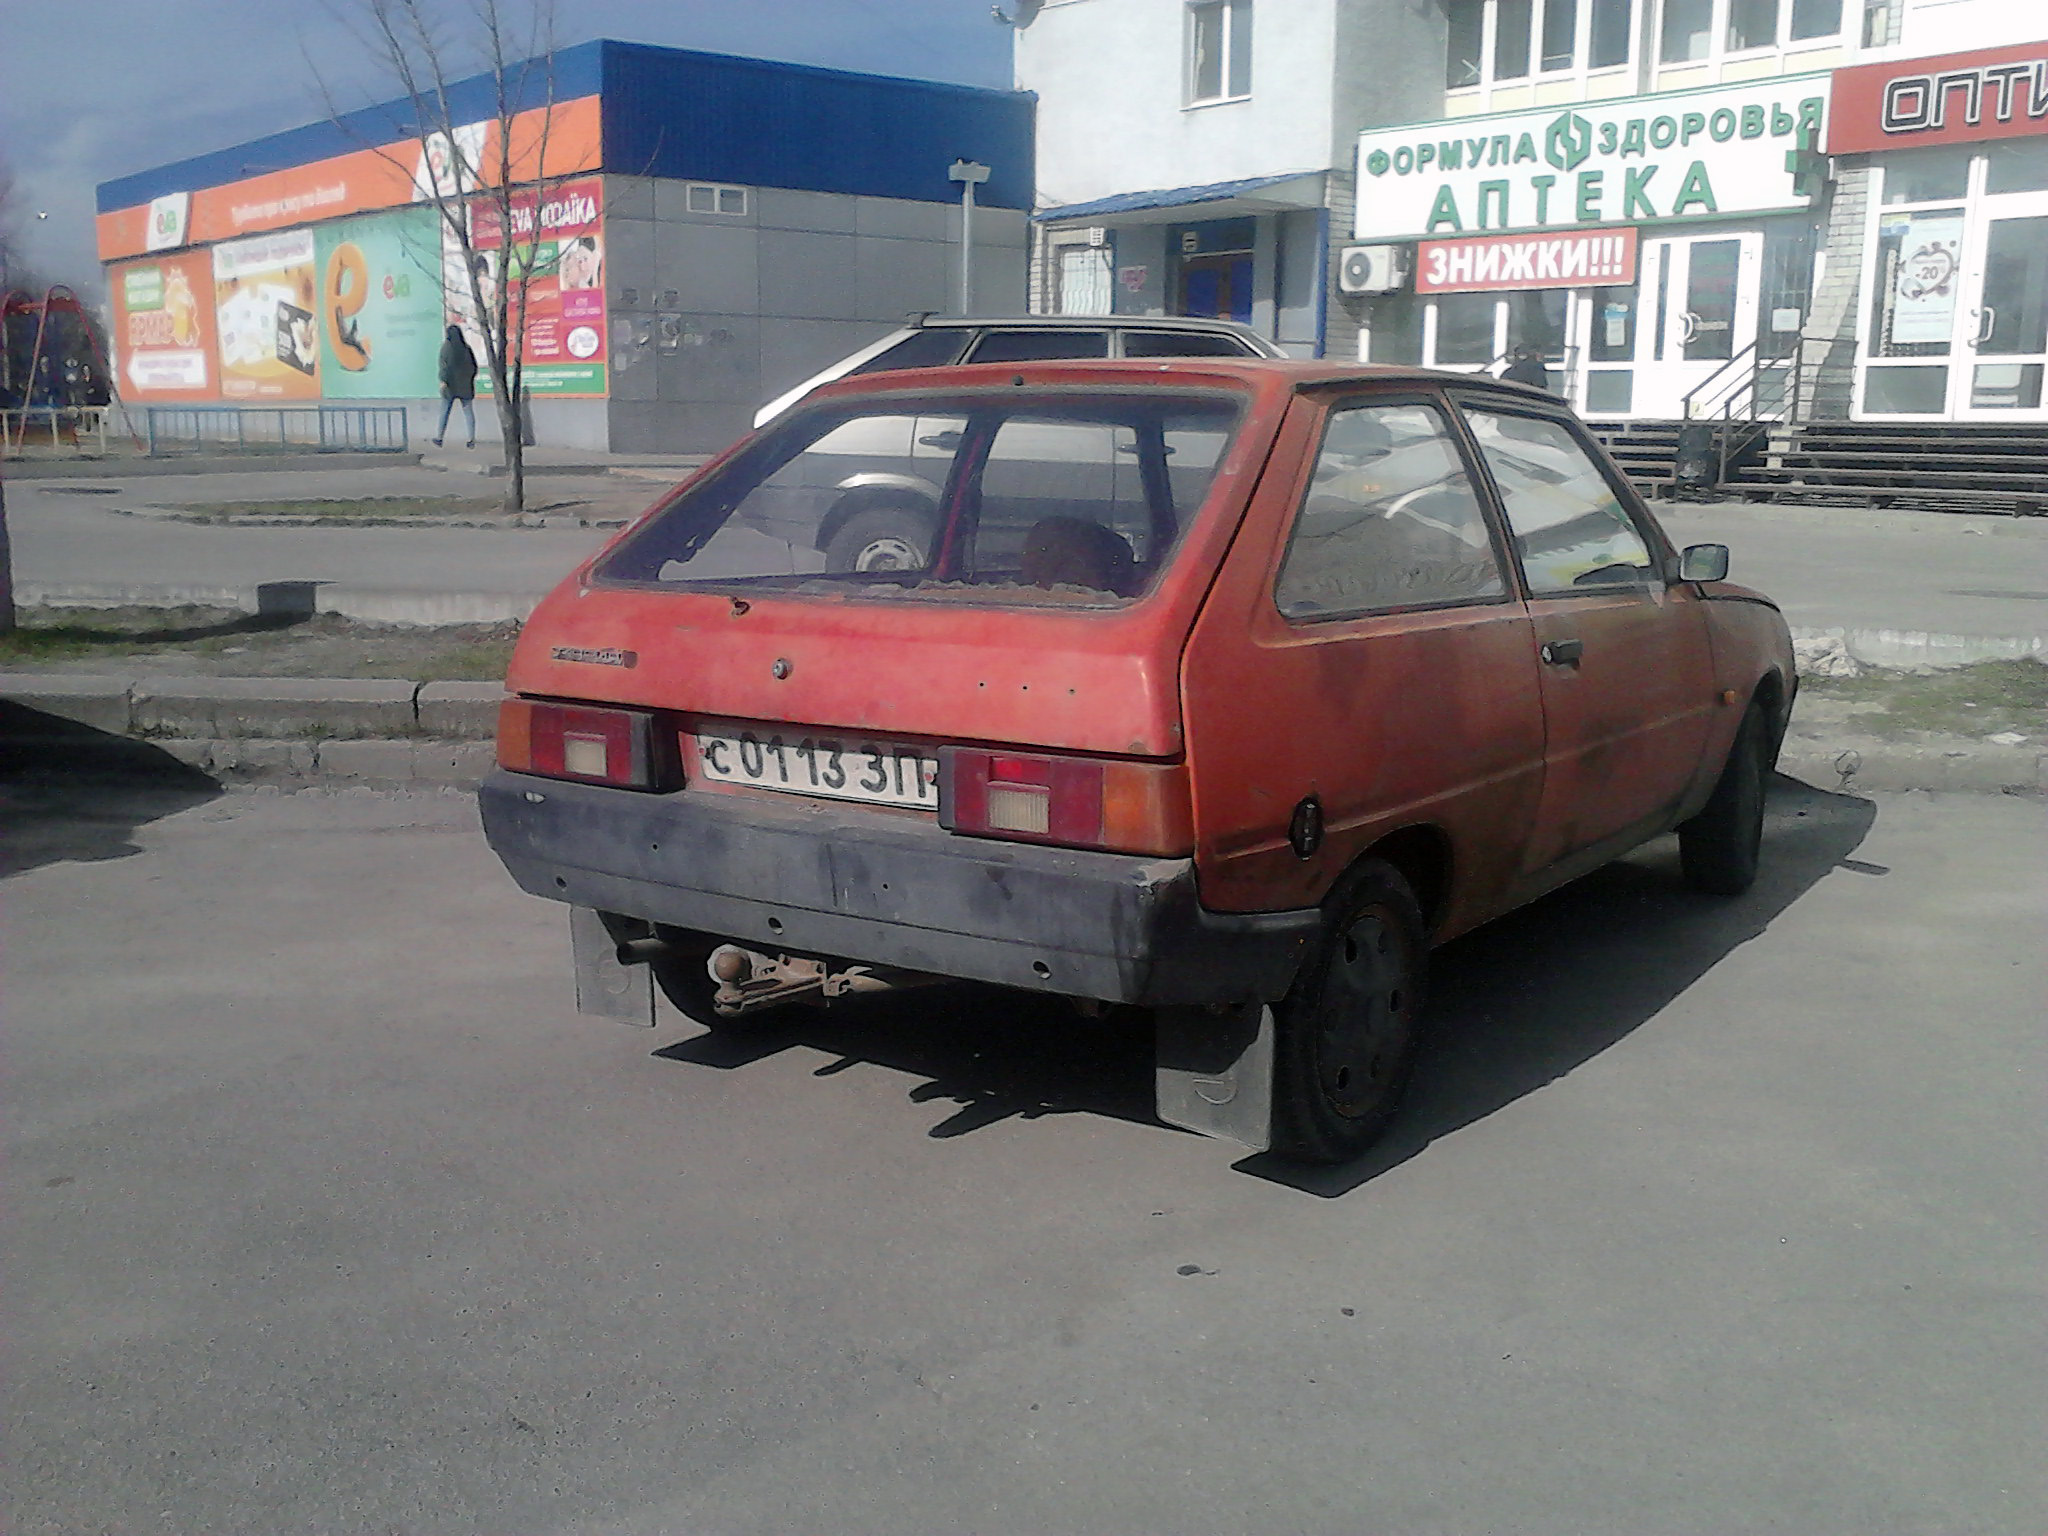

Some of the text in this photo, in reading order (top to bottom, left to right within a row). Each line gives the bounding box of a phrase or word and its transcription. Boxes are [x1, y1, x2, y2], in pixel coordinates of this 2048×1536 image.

[1366, 97, 1824, 178] ФОРМУЛА ЗДОРОВЬЯ
[1425, 160, 1719, 234] АПТЕКА
[1426, 236, 1625, 286] ЗНИЖКИ!!!
